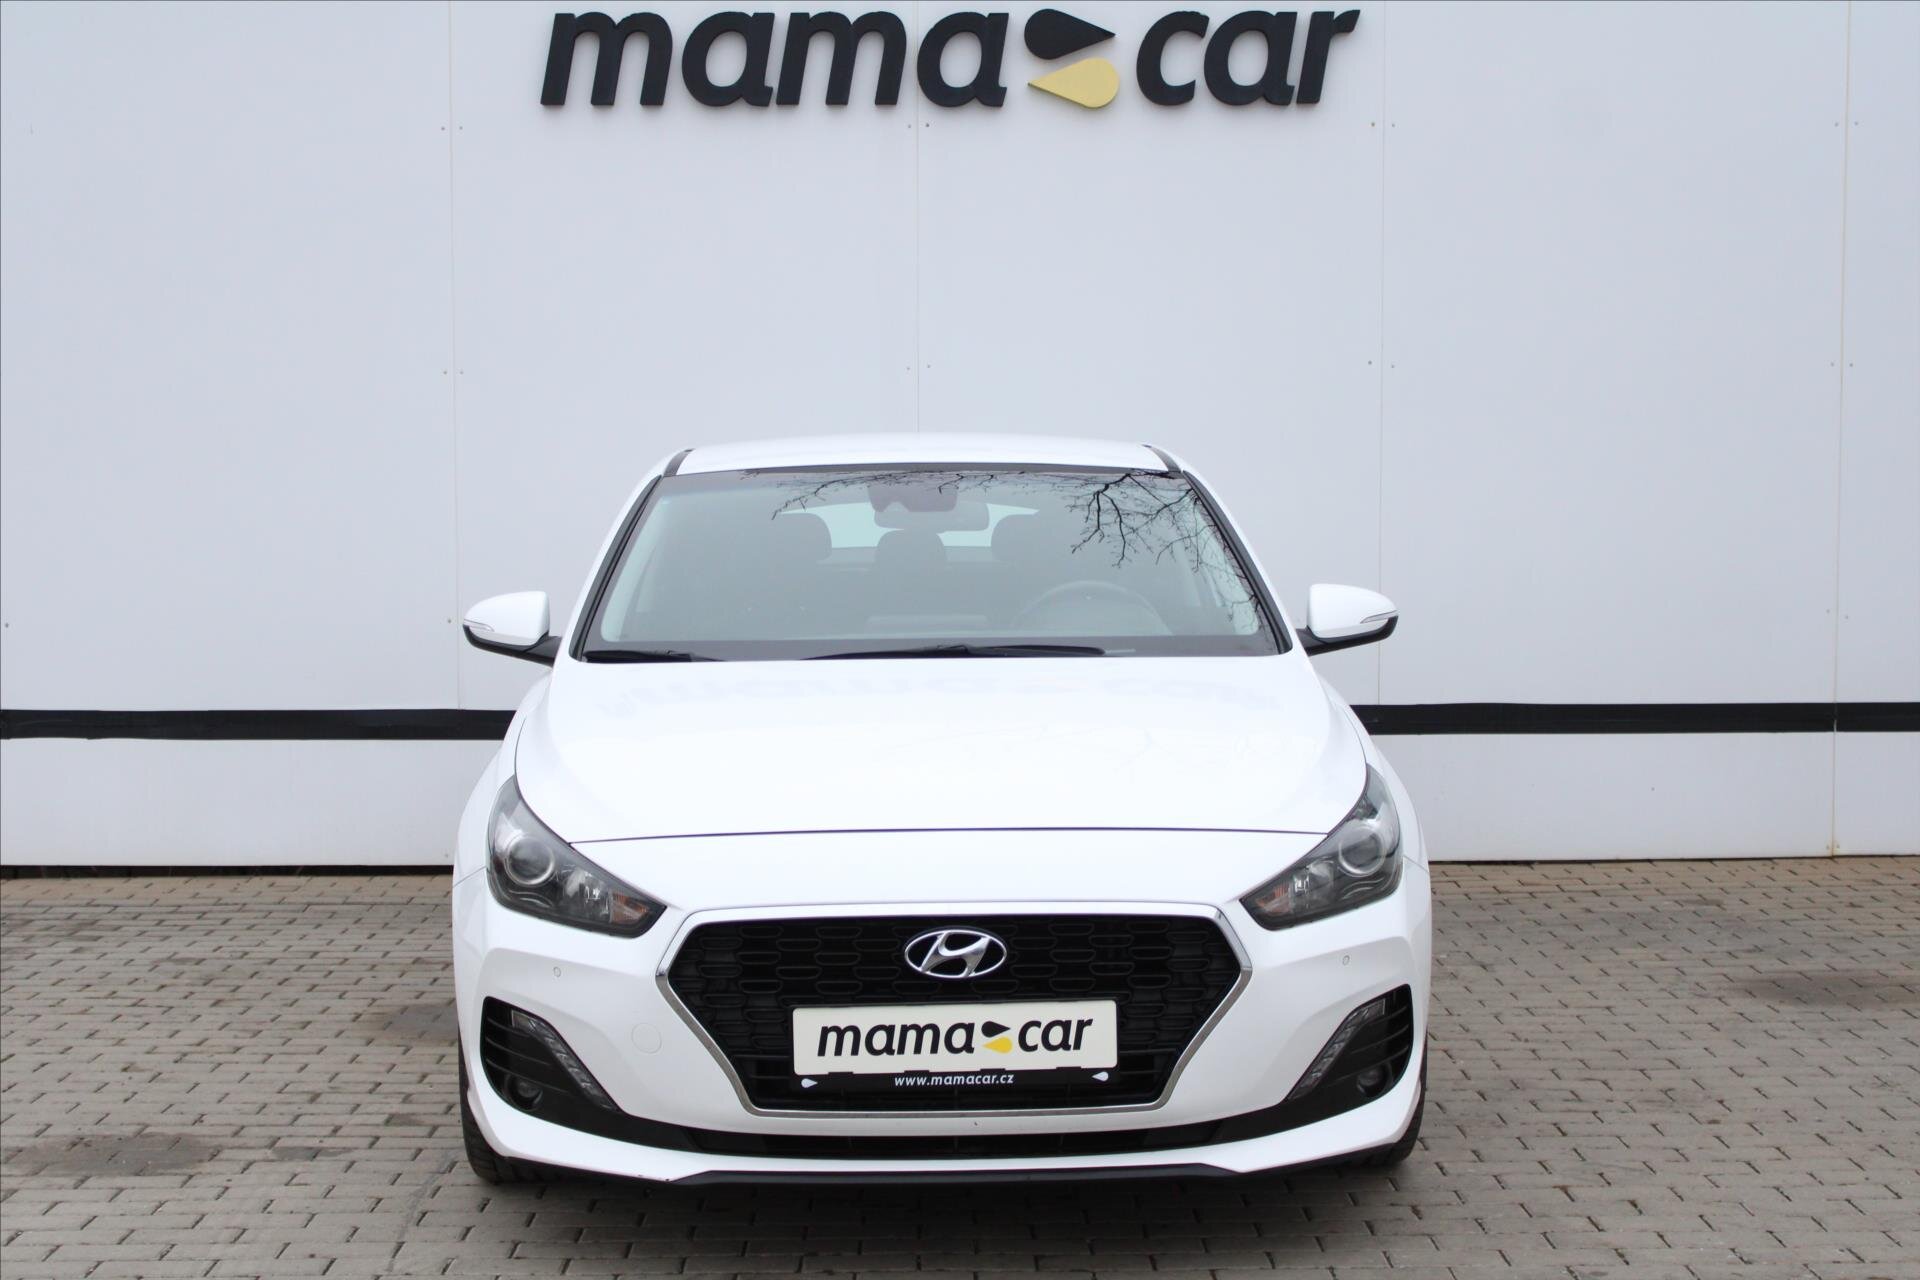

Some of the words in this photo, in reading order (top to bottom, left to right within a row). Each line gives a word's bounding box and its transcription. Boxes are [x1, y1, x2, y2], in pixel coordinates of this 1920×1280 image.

[540, 11, 1008, 109] mama
[1136, 9, 1361, 109] car
[817, 1022, 975, 1057] mama
[1017, 1018, 1094, 1053] car
[893, 1073, 1015, 1087] www.mamacar.cz
